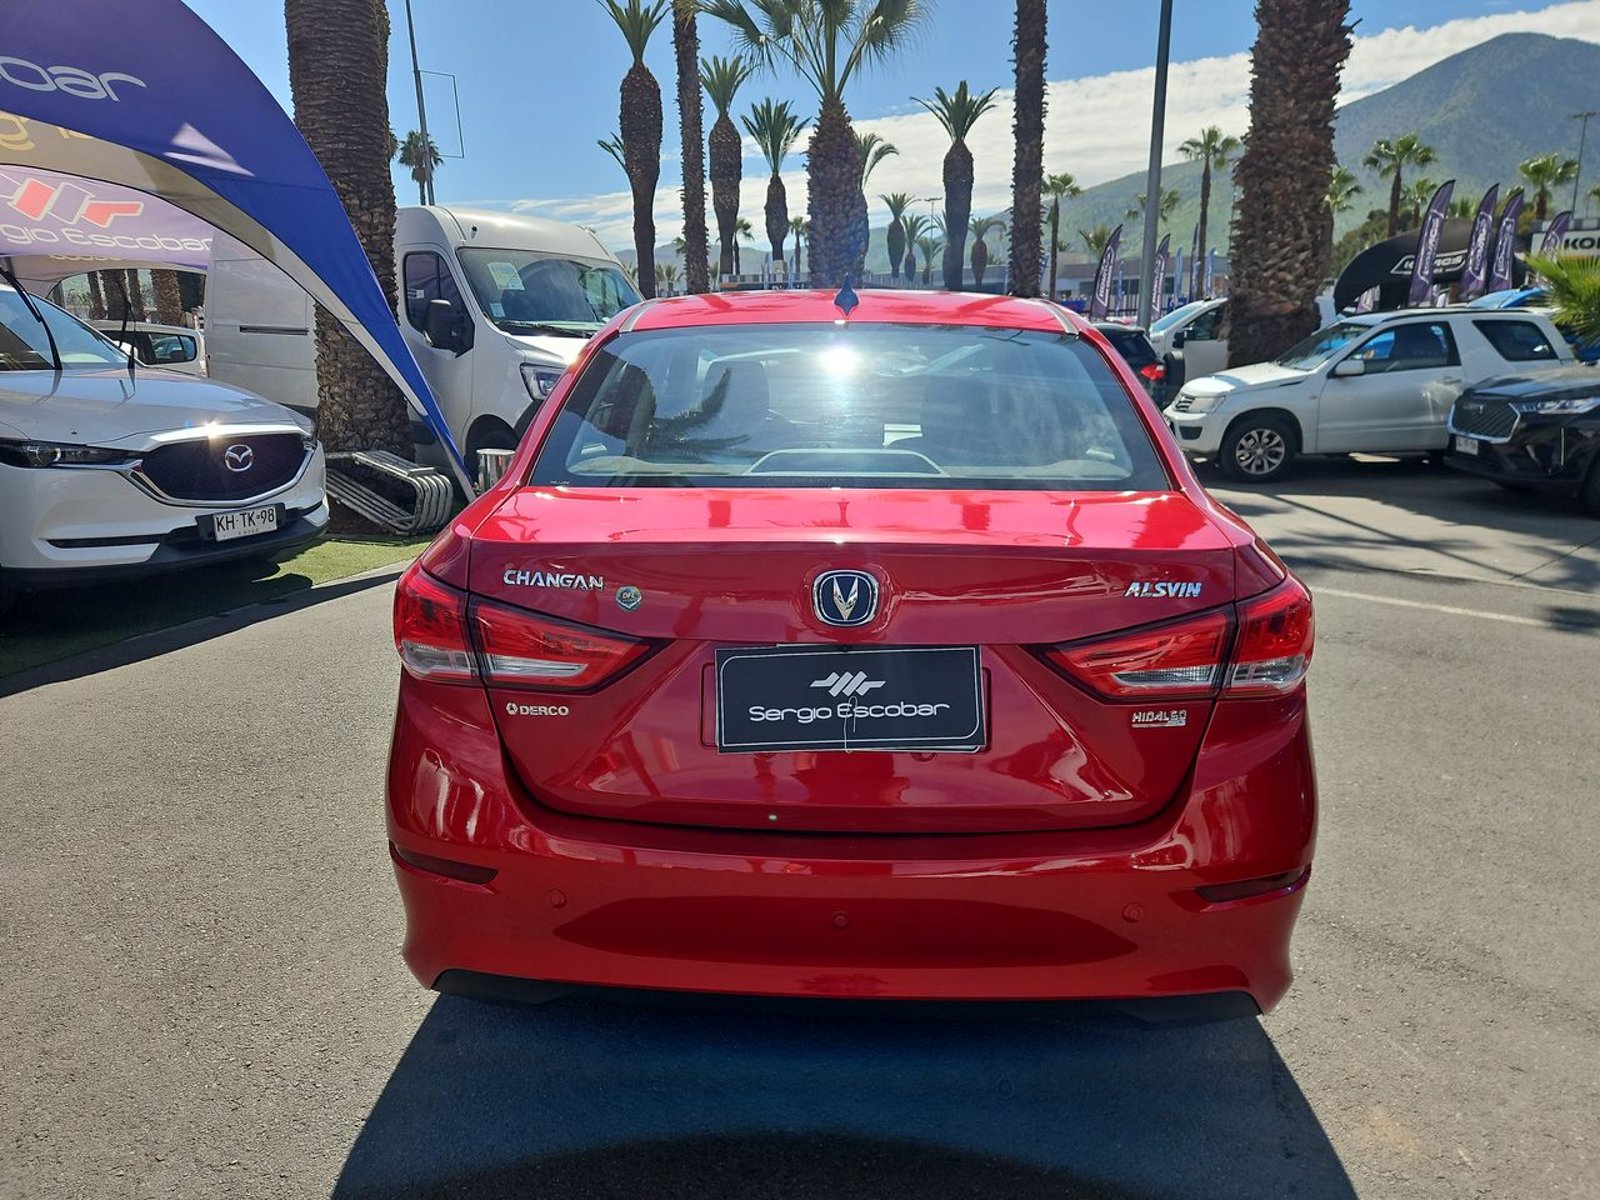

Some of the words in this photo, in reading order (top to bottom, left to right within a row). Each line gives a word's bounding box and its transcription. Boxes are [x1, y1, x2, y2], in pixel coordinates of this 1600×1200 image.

[503, 569, 604, 591] CHANGAN
[1124, 582, 1202, 598] ALSVIN
[519, 705, 570, 716] DERCO
[749, 705, 832, 723] Sergio
[837, 701, 950, 719] Escobar
